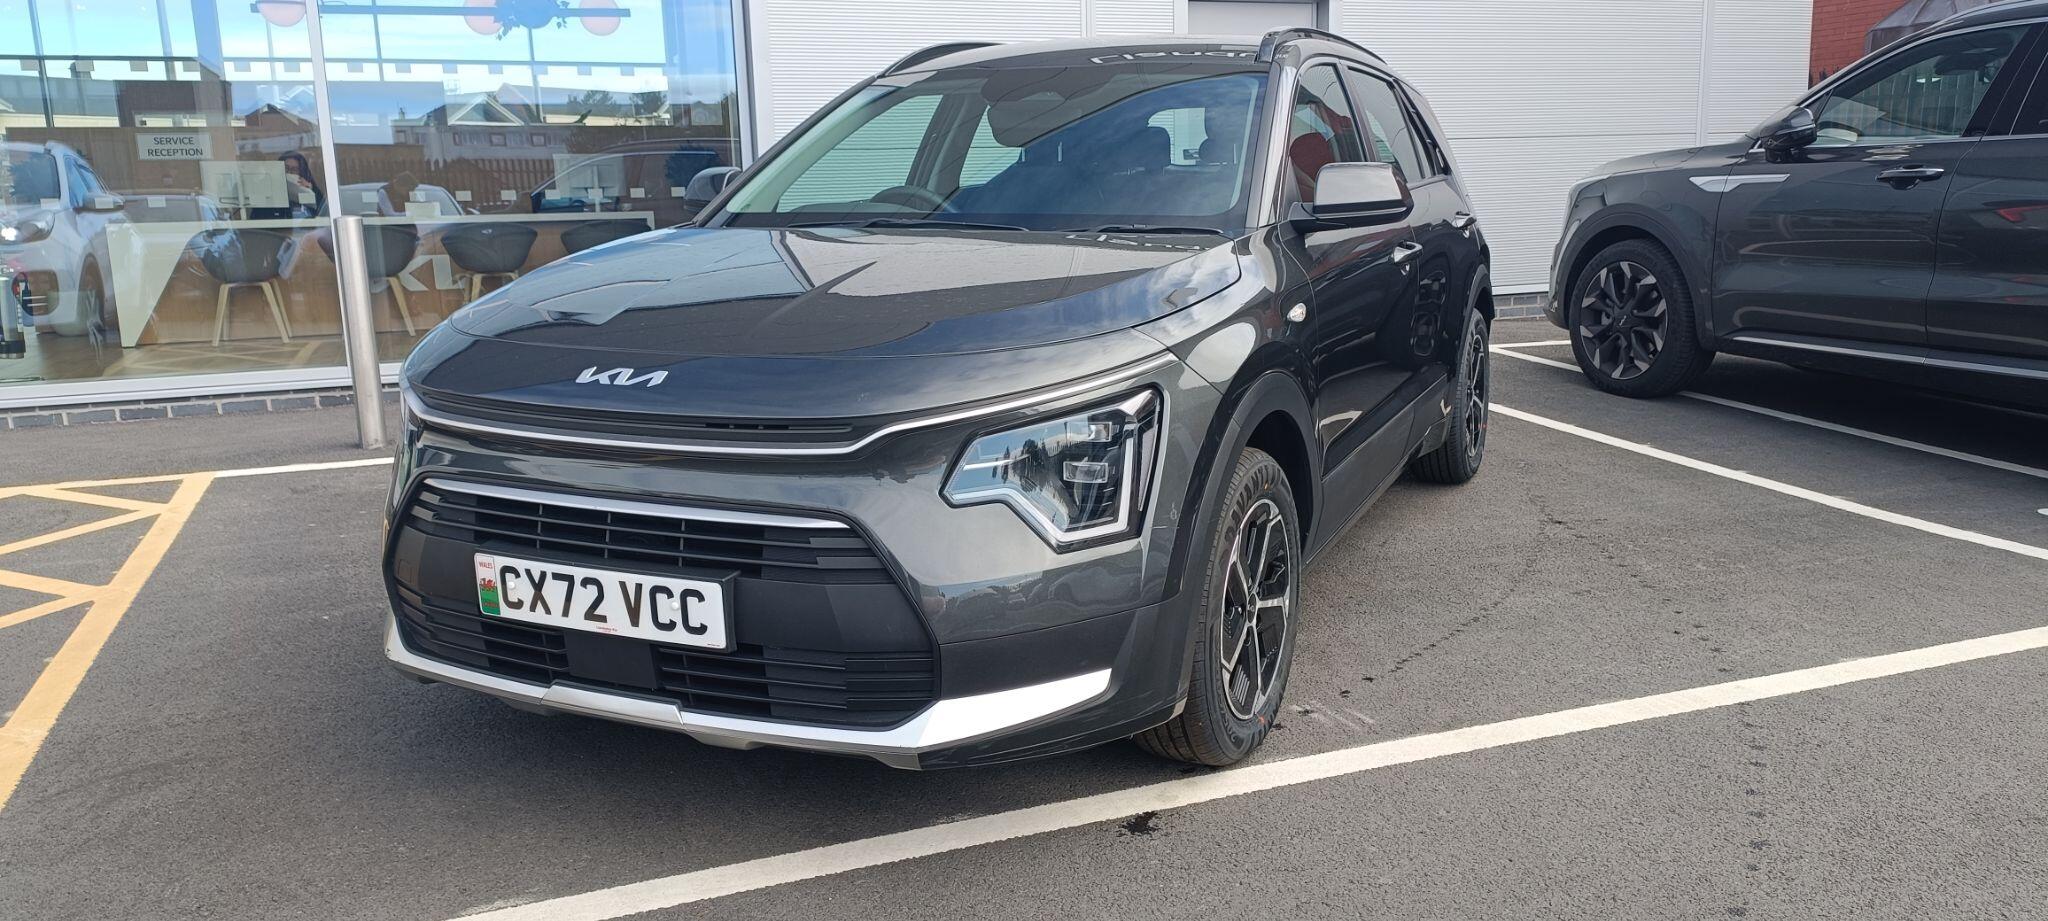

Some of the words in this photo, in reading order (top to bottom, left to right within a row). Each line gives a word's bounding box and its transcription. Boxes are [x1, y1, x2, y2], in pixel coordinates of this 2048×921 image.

[153, 136, 195, 146] SERVICE
[147, 148, 204, 157] RECEPTION
[479, 561, 494, 569] WALES
[499, 565, 608, 624] CX72
[618, 580, 709, 636] VCC
